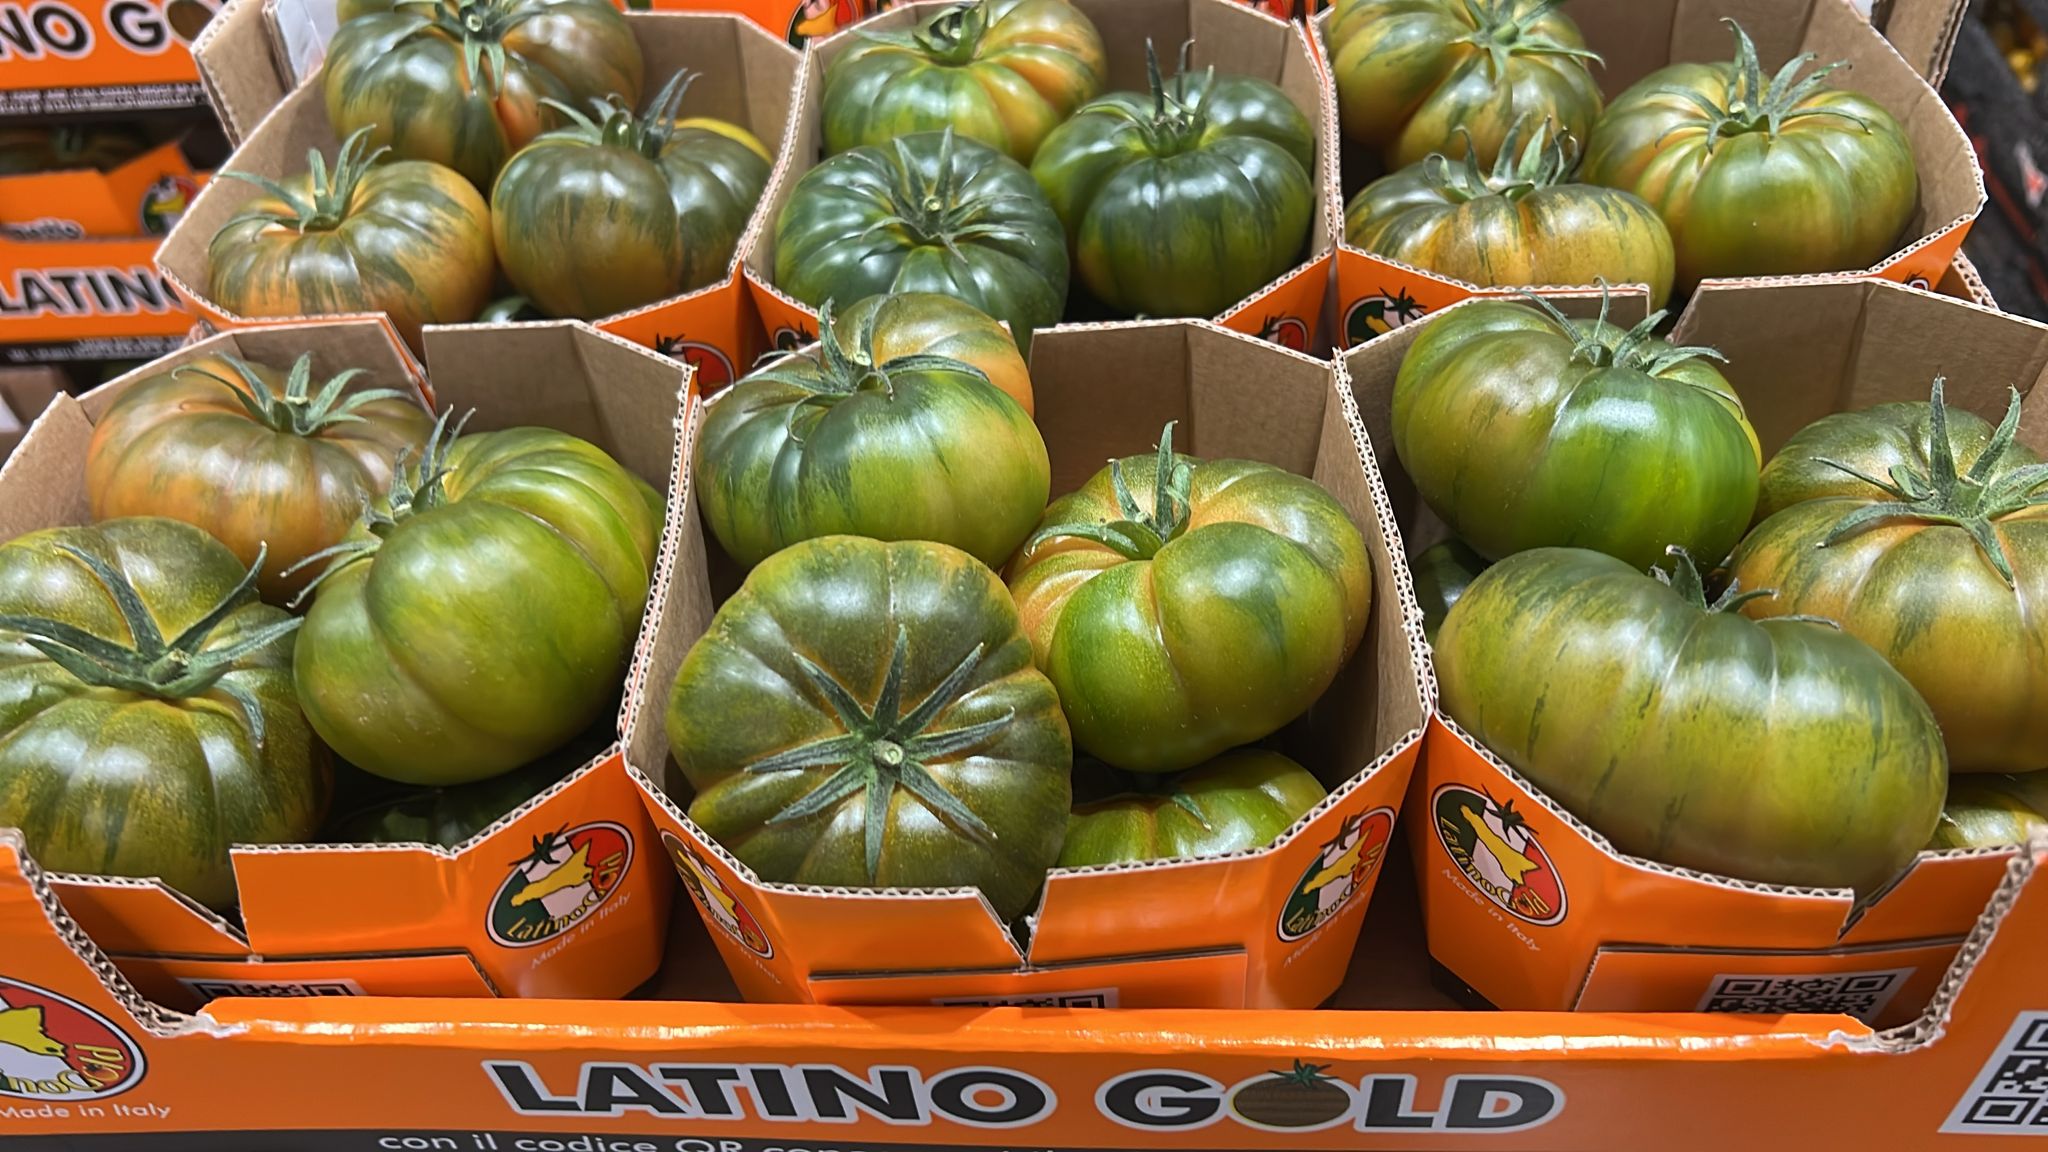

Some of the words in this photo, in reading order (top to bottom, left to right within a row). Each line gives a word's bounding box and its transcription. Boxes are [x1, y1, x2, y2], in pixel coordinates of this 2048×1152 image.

[531, 932, 576, 970] Made
[579, 919, 596, 934] in
[600, 891, 632, 919] Italy
[1442, 868, 1485, 906] Made
[1487, 907, 1504, 922] in
[1506, 922, 1541, 952] Italy
[78, 1104, 105, 1117] in
[112, 1102, 171, 1119] Italy
[486, 1061, 1054, 1127] LATINO
[1098, 1060, 1563, 1131] GOLD
[378, 1135, 458, 1150] con
[472, 1132, 498, 1150] il
[514, 1134, 658, 1152] codice
[674, 1138, 743, 1152] QR
